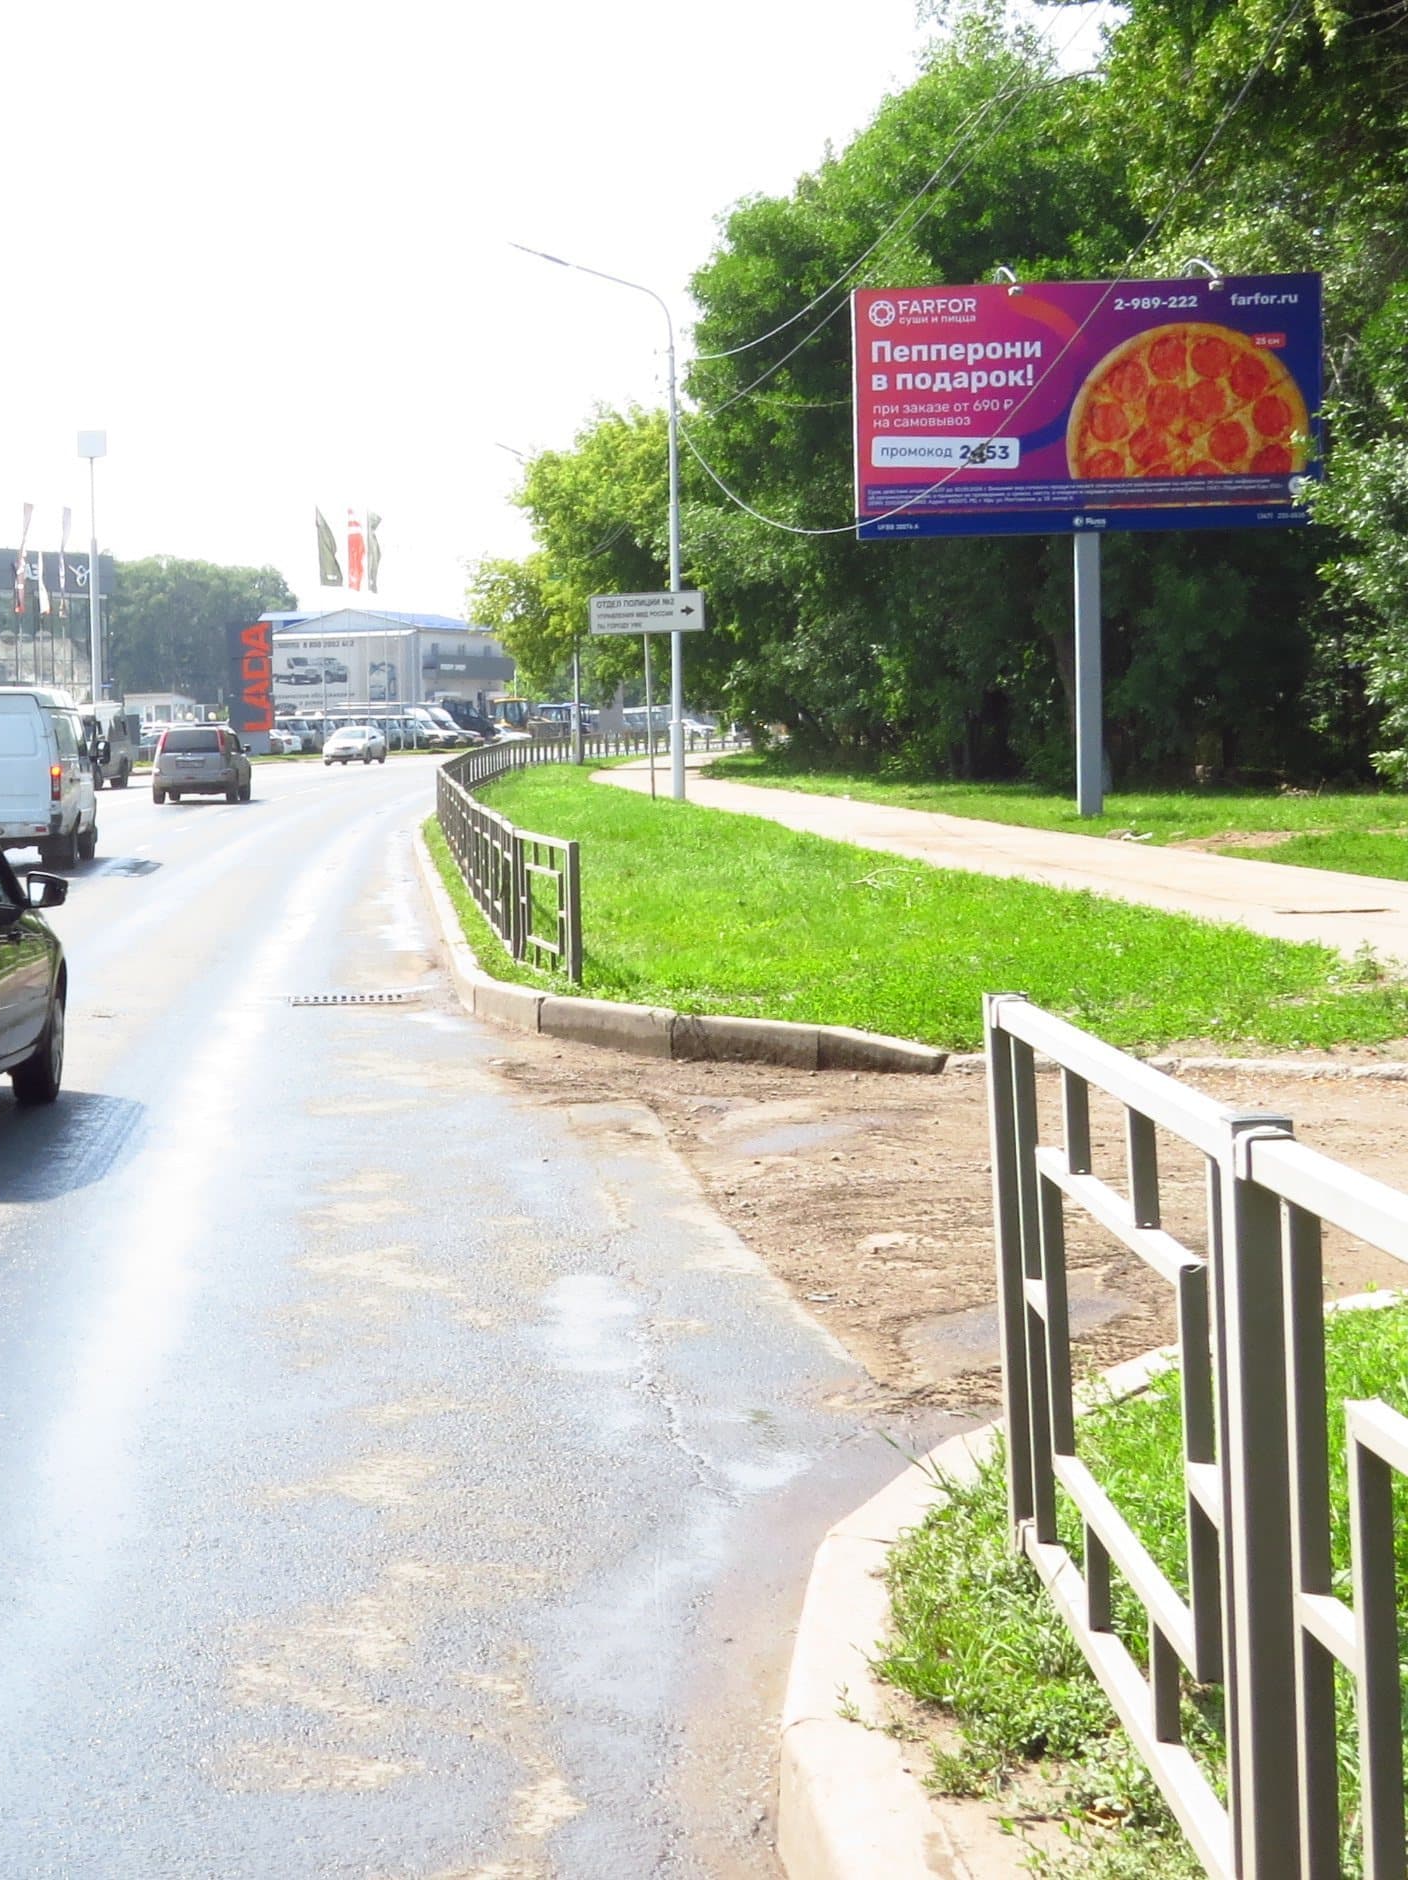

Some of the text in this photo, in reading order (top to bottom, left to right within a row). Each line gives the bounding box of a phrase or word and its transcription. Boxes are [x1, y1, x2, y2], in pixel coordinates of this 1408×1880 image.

[898, 298, 976, 315] FARFOR
[1114, 296, 1198, 310] 2-989-222
[1230, 293, 1298, 306] farfor.ru
[899, 317, 929, 326] суши
[941, 315, 976, 324] пицца
[871, 341, 1041, 365] Пепперони
[872, 364, 1034, 393] в подарок!
[873, 404, 899, 416] при
[903, 402, 949, 414] заказе
[953, 402, 969, 412] от
[973, 399, 1000, 412] 690
[873, 416, 970, 428] на самовывоз
[880, 445, 1010, 460] промокод 253
[596, 600, 622, 609] ОТДЕЛ
[624, 598, 661, 608] ПОЛИЦИИ
[240, 621, 273, 732] LADA
